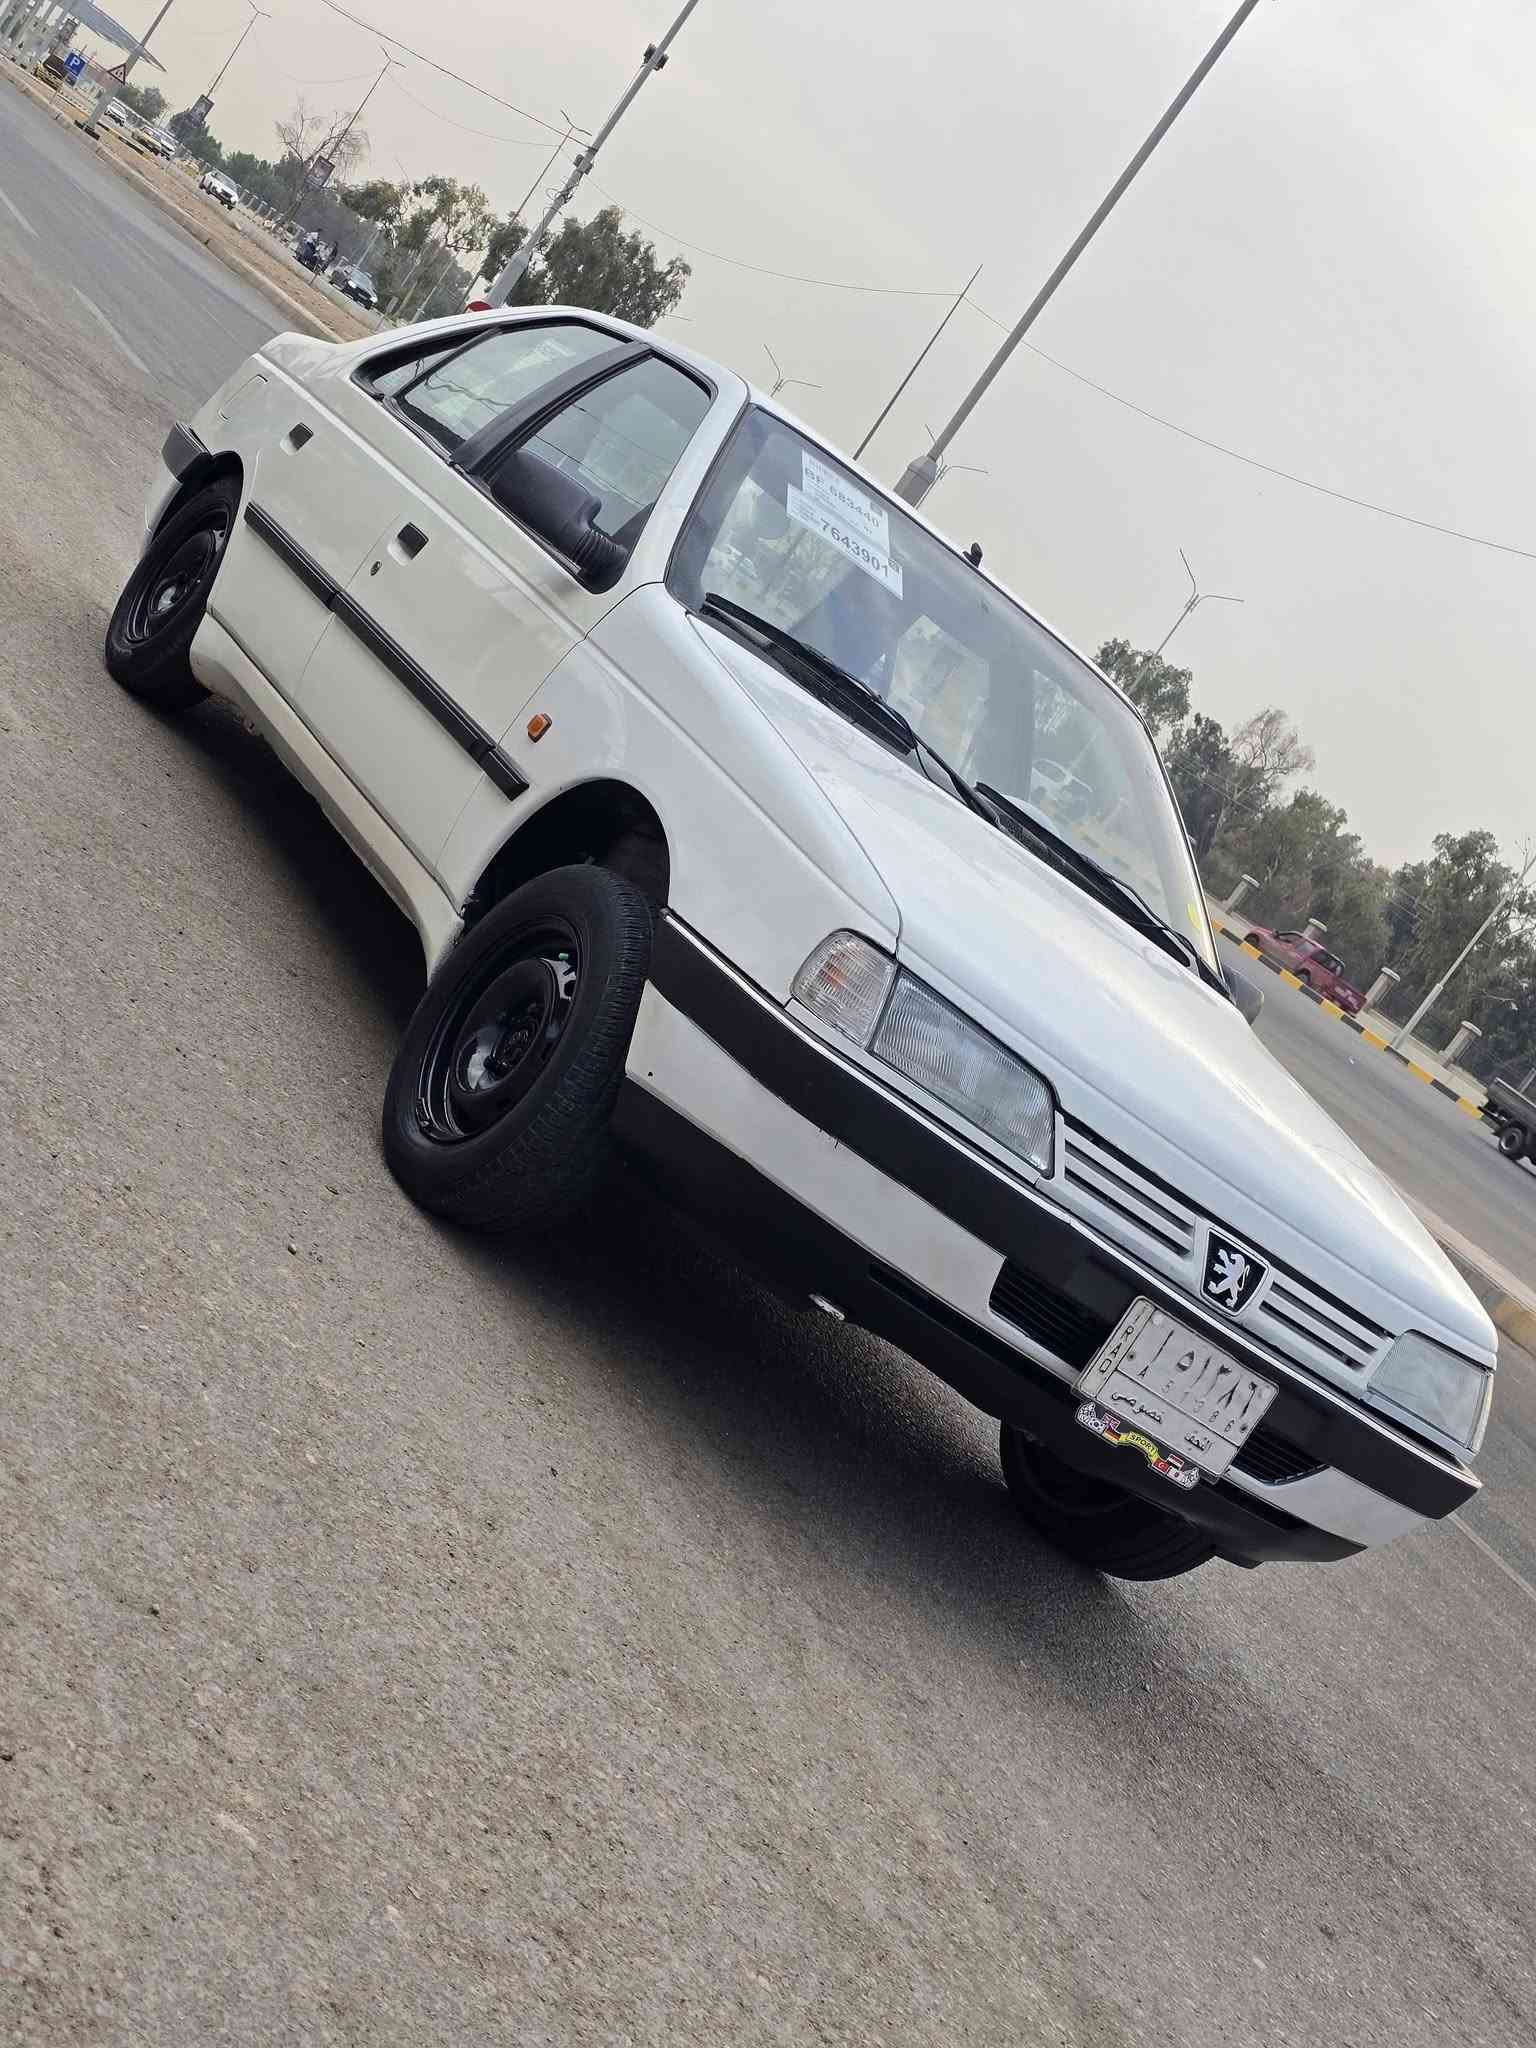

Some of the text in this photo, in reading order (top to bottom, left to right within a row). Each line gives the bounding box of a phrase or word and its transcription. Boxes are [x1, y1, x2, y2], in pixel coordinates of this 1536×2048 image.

[69, 55, 81, 68] P
[820, 517, 889, 576] 7643901
[1111, 1392, 1164, 1424] خصوصي
[1130, 1434, 1158, 1456] SPORT
